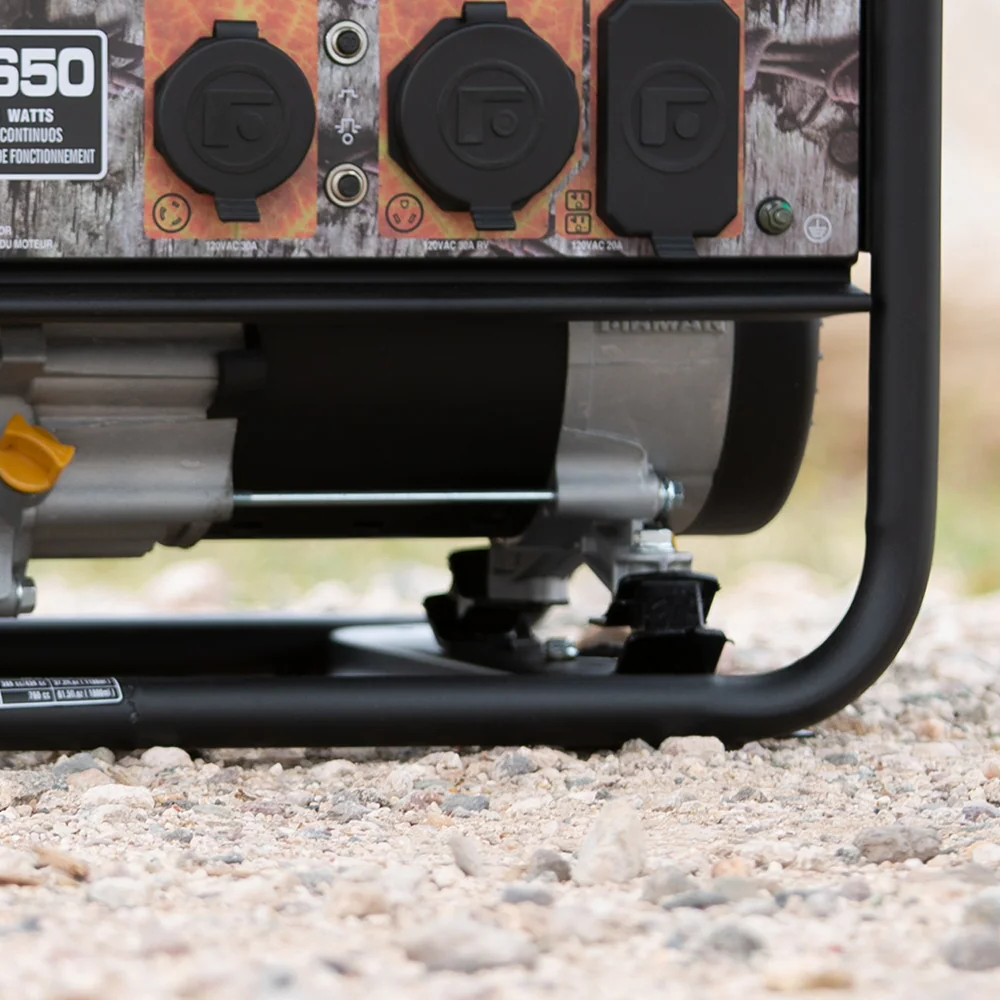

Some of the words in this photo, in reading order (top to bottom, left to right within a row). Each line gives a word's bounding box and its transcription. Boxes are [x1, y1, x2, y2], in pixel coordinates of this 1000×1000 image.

[7, 108, 54, 123] WATTS
[0, 127, 63, 143] CONTINUOS
[10, 148, 96, 164] FONCTIONNEMENT
[0, 239, 12, 249] DU
[14, 239, 53, 249] MOTEUR
[206, 241, 239, 251] 120VAC
[423, 241, 457, 251] 120VAC
[476, 241, 489, 251] RV
[571, 240, 605, 250] 120VAC
[606, 240, 623, 250] 20A
